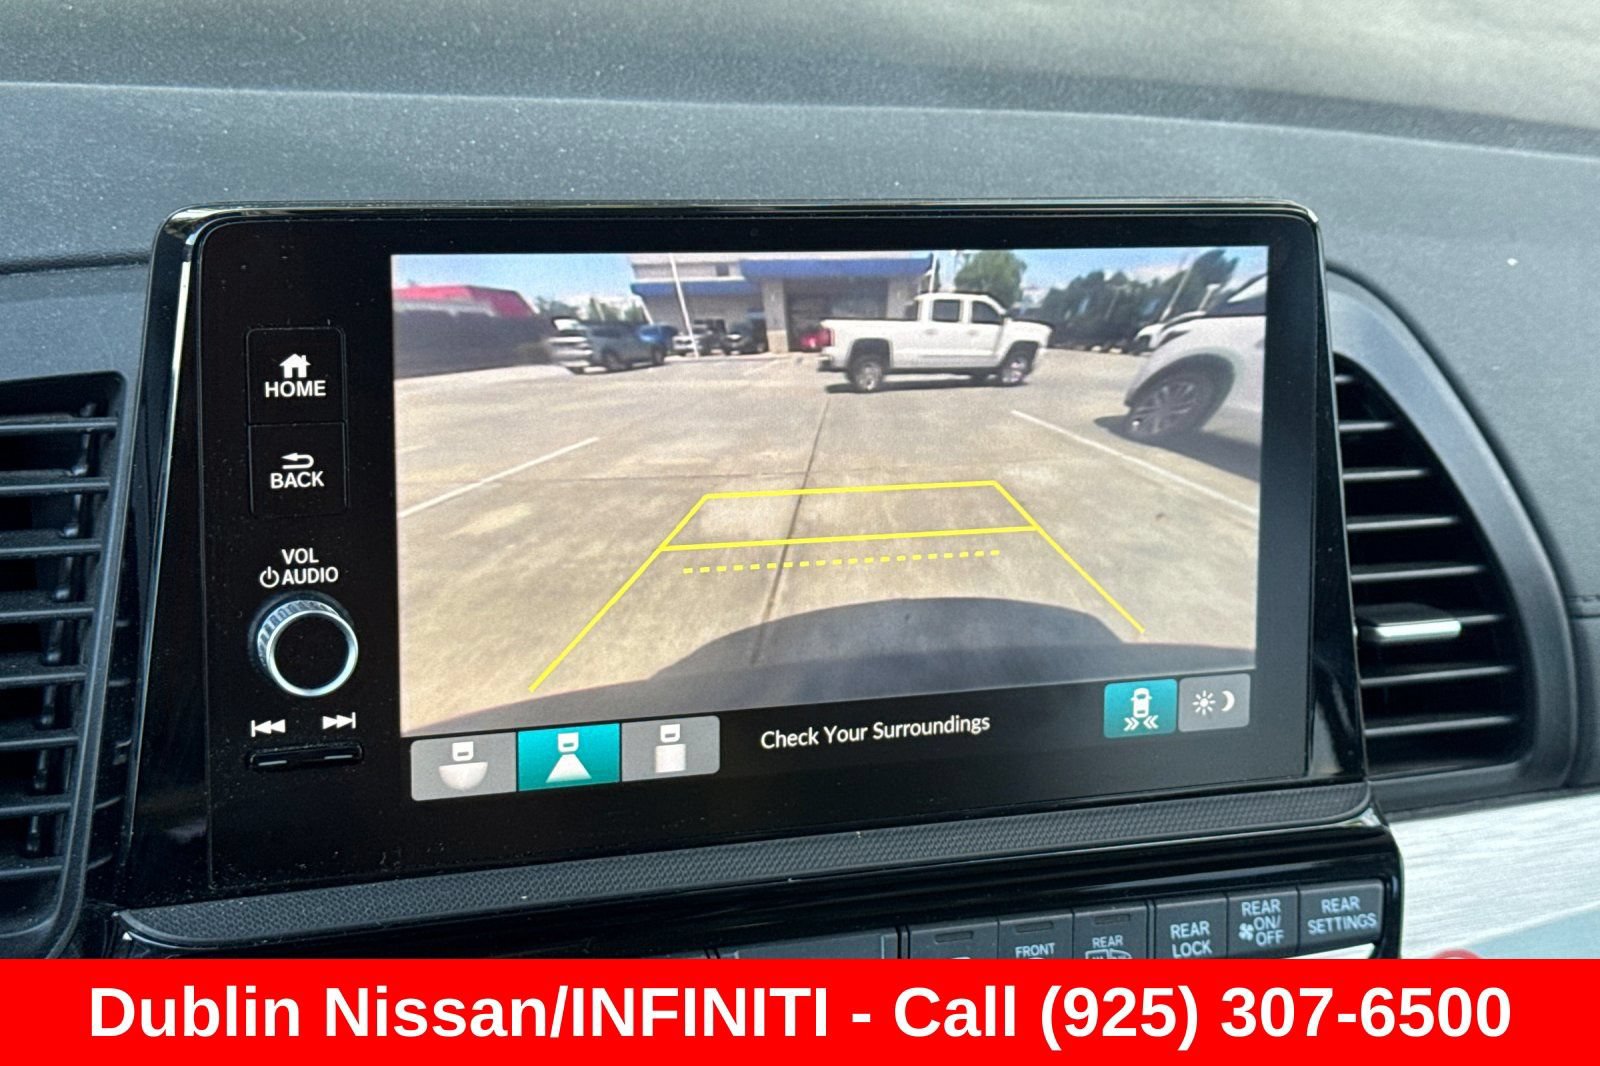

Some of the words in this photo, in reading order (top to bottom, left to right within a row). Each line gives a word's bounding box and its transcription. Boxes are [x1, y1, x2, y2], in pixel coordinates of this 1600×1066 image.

[264, 380, 327, 398] HOME
[269, 471, 325, 490] BACK
[281, 547, 320, 565] VOL
[281, 566, 339, 586] AUDIO
[760, 727, 819, 749] Check
[823, 725, 869, 744] Your
[872, 715, 991, 740] Surroundings
[1241, 899, 1281, 917] REAR
[1320, 896, 1361, 914] REAR
[1170, 920, 1211, 940] REAR
[1253, 914, 1281, 931] ON/
[1307, 913, 1377, 935] SETTINGS
[1091, 934, 1124, 949] REAR
[1255, 929, 1285, 947] OFF
[1015, 942, 1056, 959] FRONT
[1171, 939, 1213, 959] LOCK
